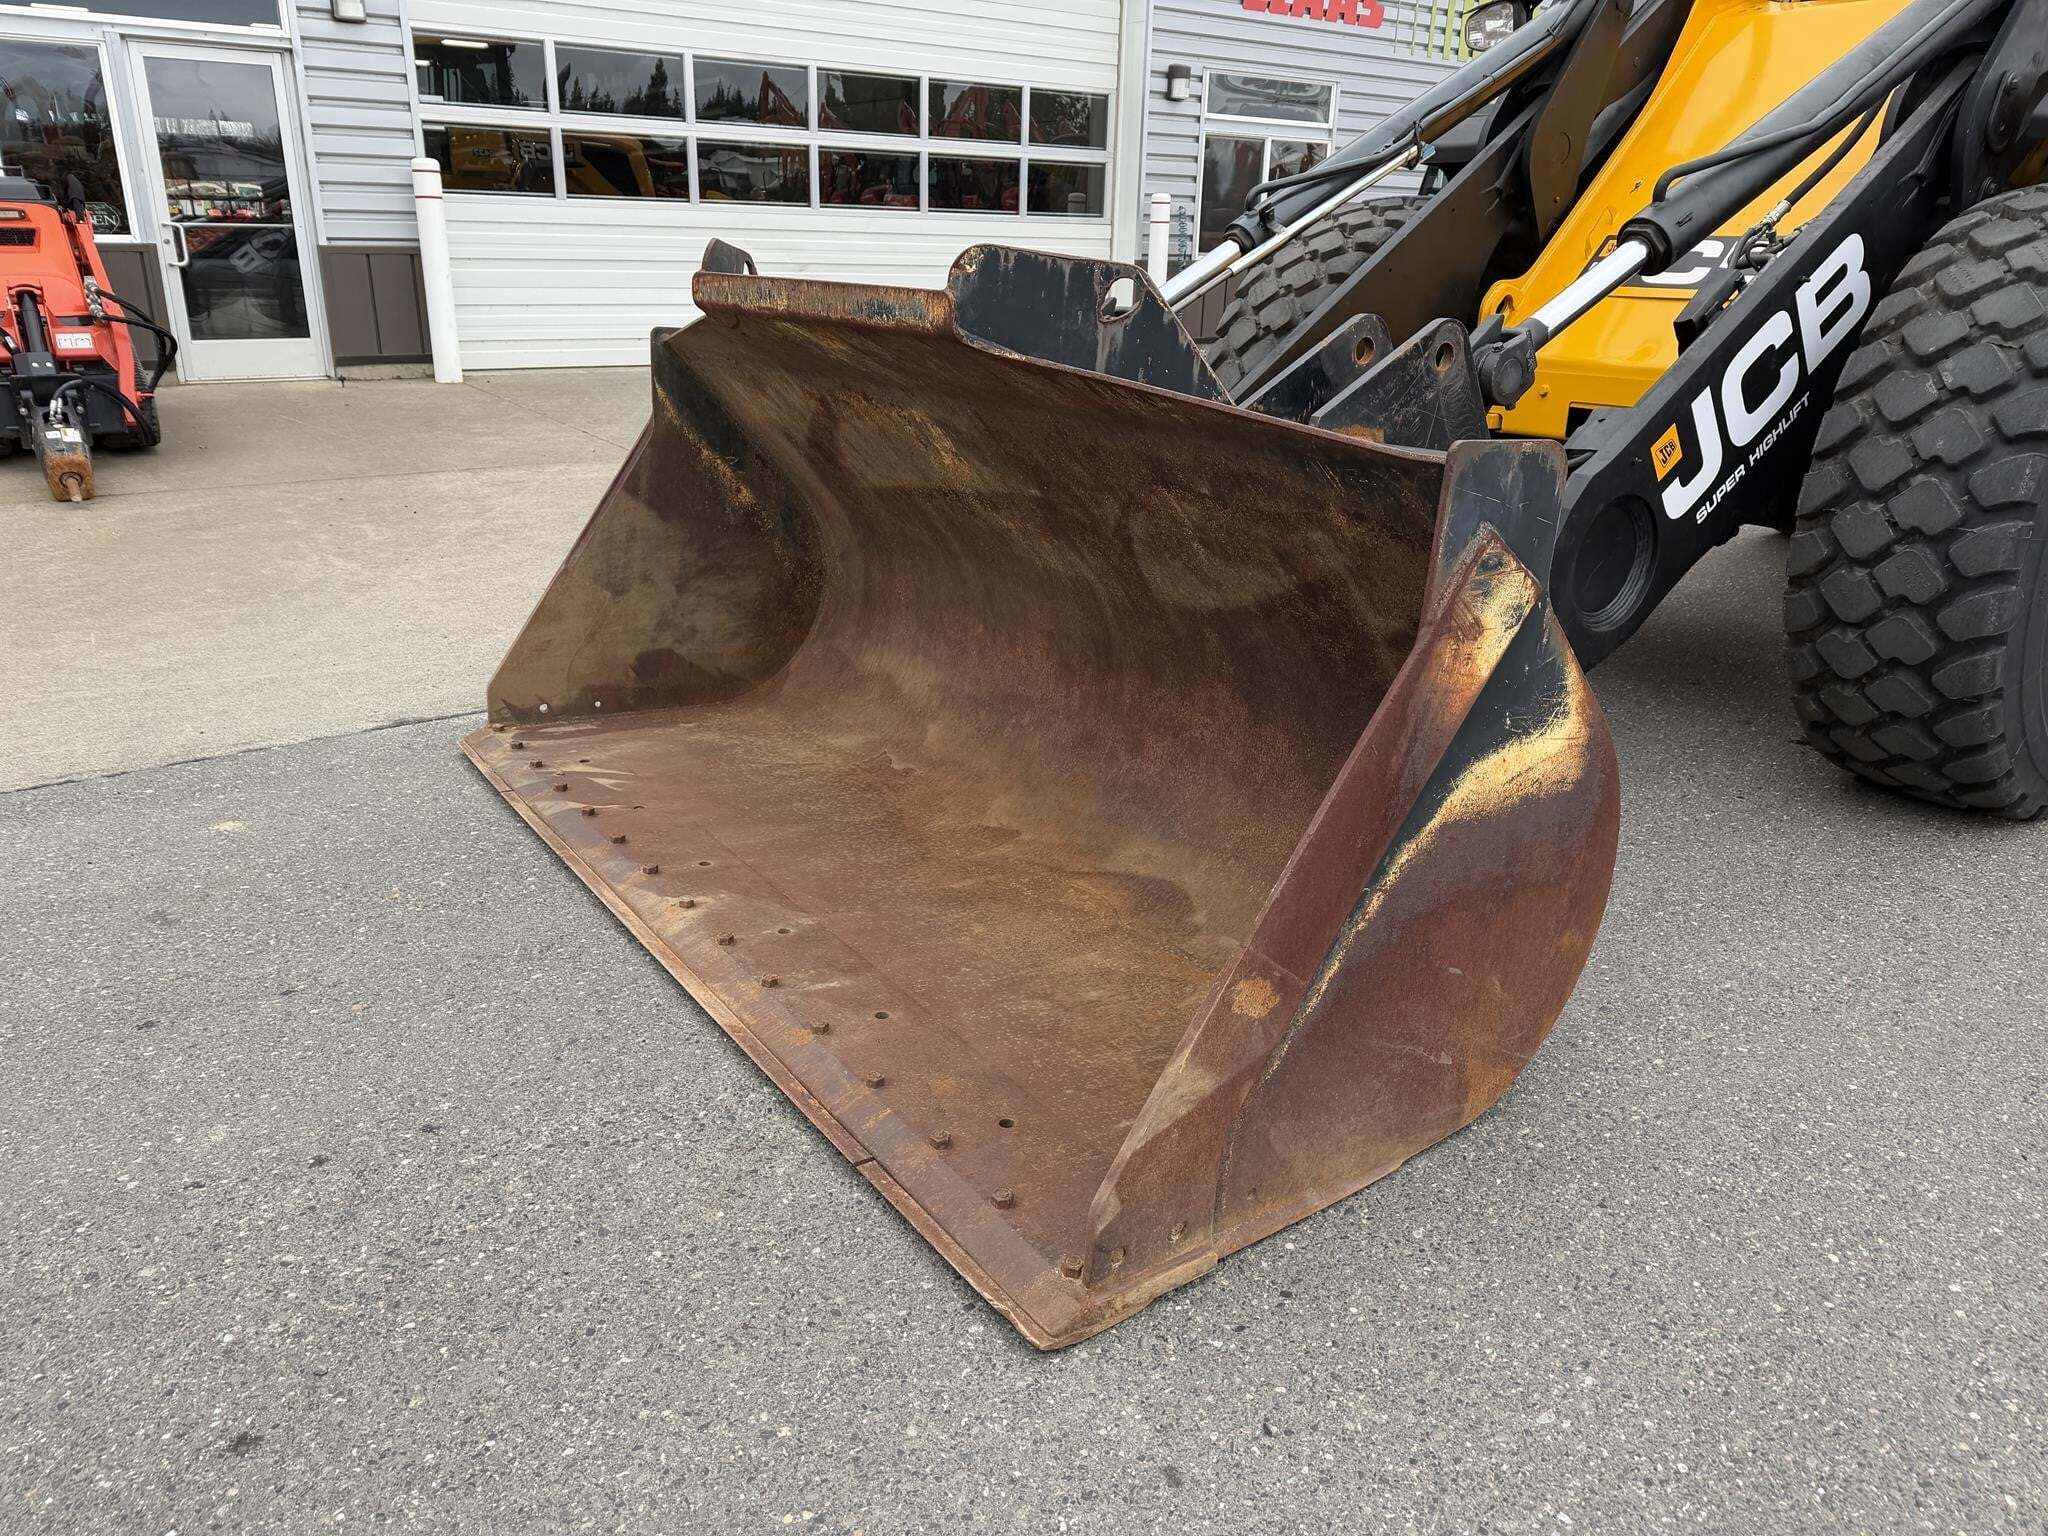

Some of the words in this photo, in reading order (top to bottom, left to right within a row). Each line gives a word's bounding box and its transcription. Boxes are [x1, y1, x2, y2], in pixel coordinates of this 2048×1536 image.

[1242, 0, 1384, 29] AAS
[1661, 233, 1871, 520] JCB
[1657, 440, 1677, 467] JCB
[1695, 464, 1746, 525] SUPER
[1748, 391, 1810, 467] HIGHLIFT
